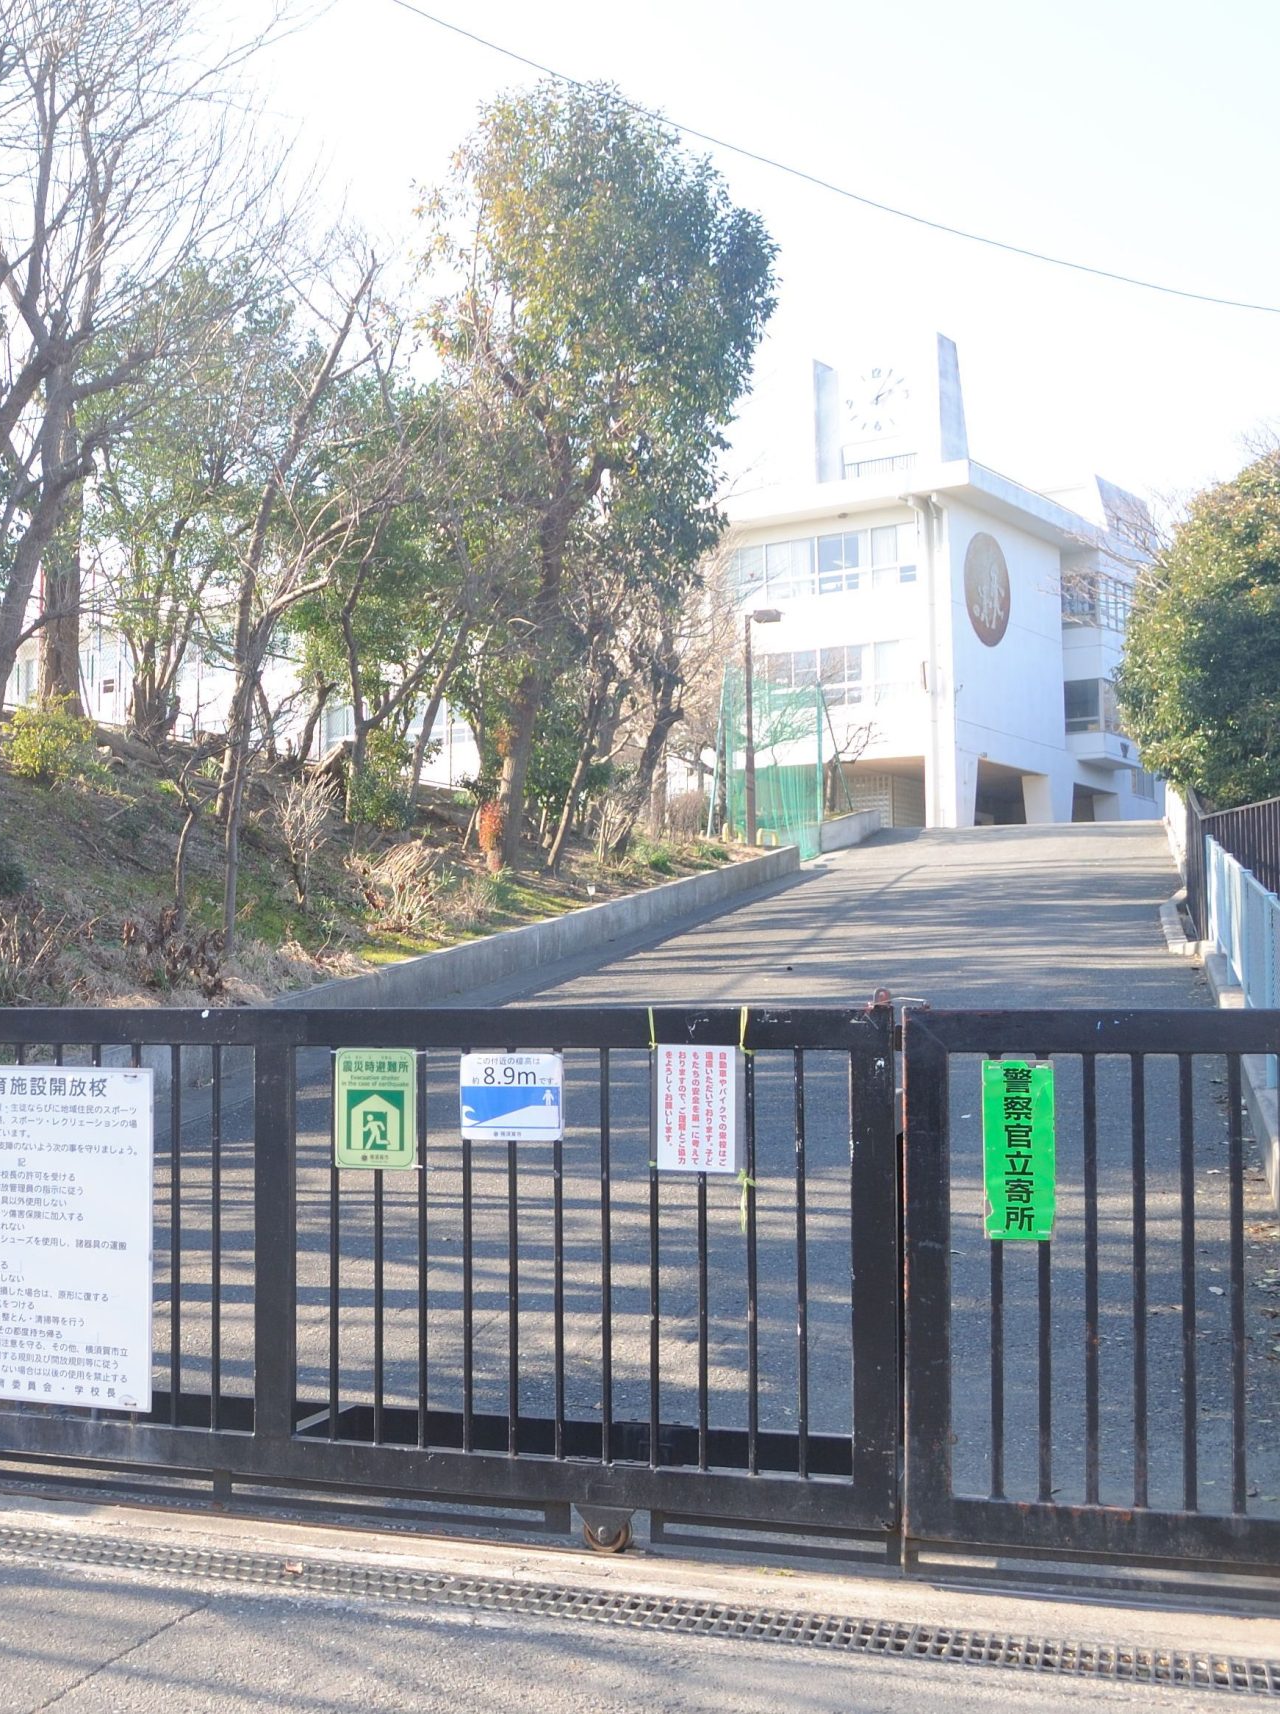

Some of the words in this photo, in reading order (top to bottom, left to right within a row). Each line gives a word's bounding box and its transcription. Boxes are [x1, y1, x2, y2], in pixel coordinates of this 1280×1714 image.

[343, 1061, 408, 1072] 震災時避難所
[483, 1066, 536, 1084] 8.9m
[1003, 1068, 1035, 1232] 警察官立寄所
[17, 1158, 26, 1167] 記
